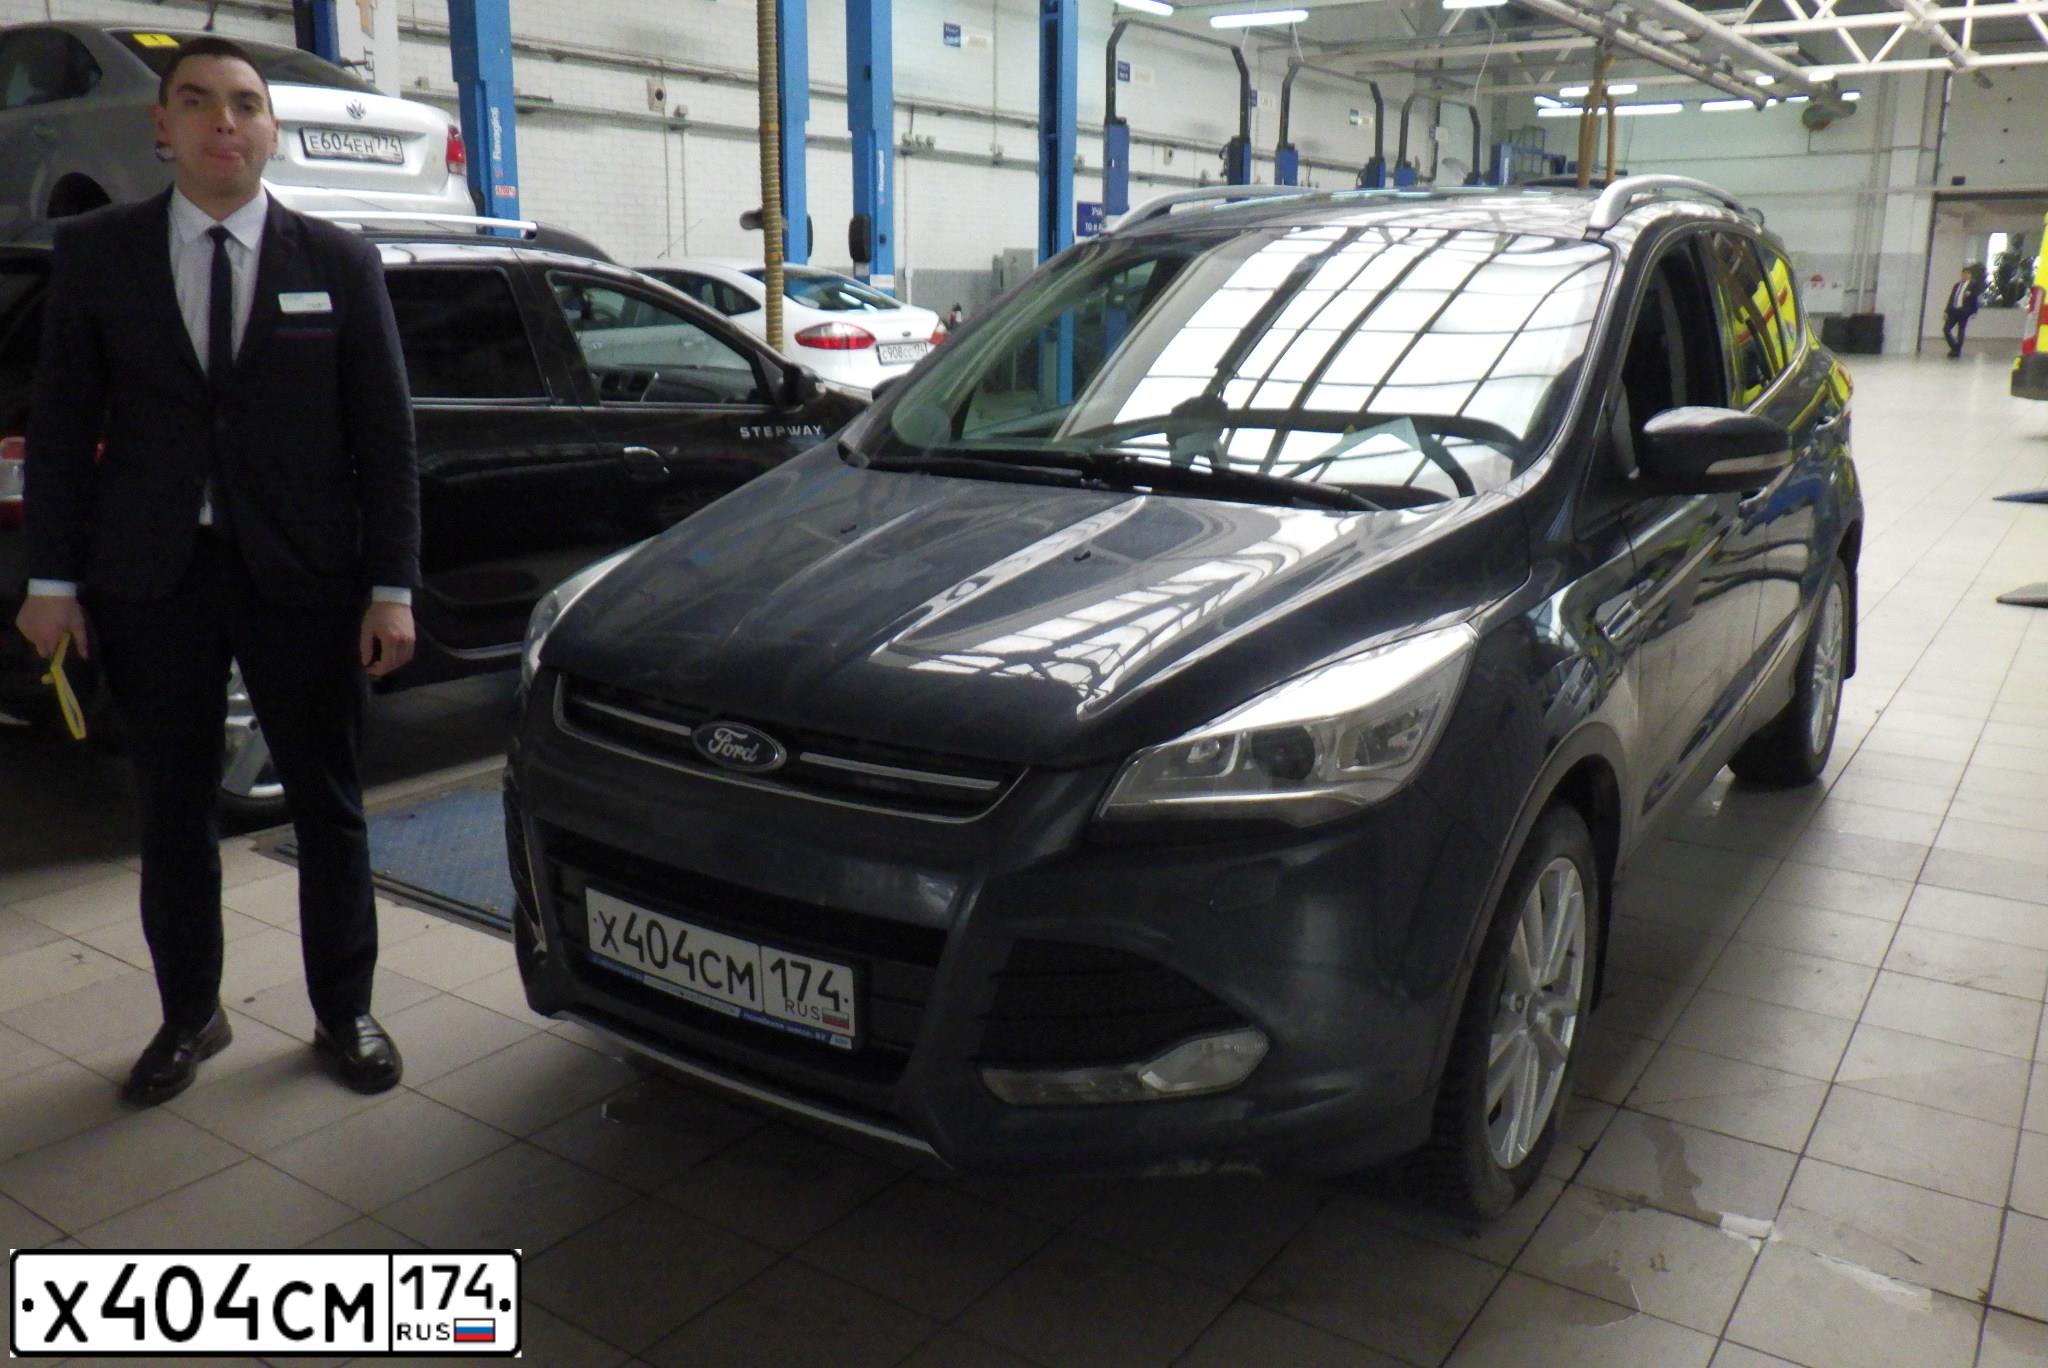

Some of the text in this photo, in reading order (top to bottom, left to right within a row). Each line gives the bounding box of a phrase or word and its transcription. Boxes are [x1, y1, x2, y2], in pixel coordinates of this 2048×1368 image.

[740, 425, 821, 439] STEPWAY
[708, 728, 760, 762] Ford
[599, 911, 755, 1002] Х404СМ
[770, 958, 840, 1011] 174
[785, 999, 820, 1021] RUS
